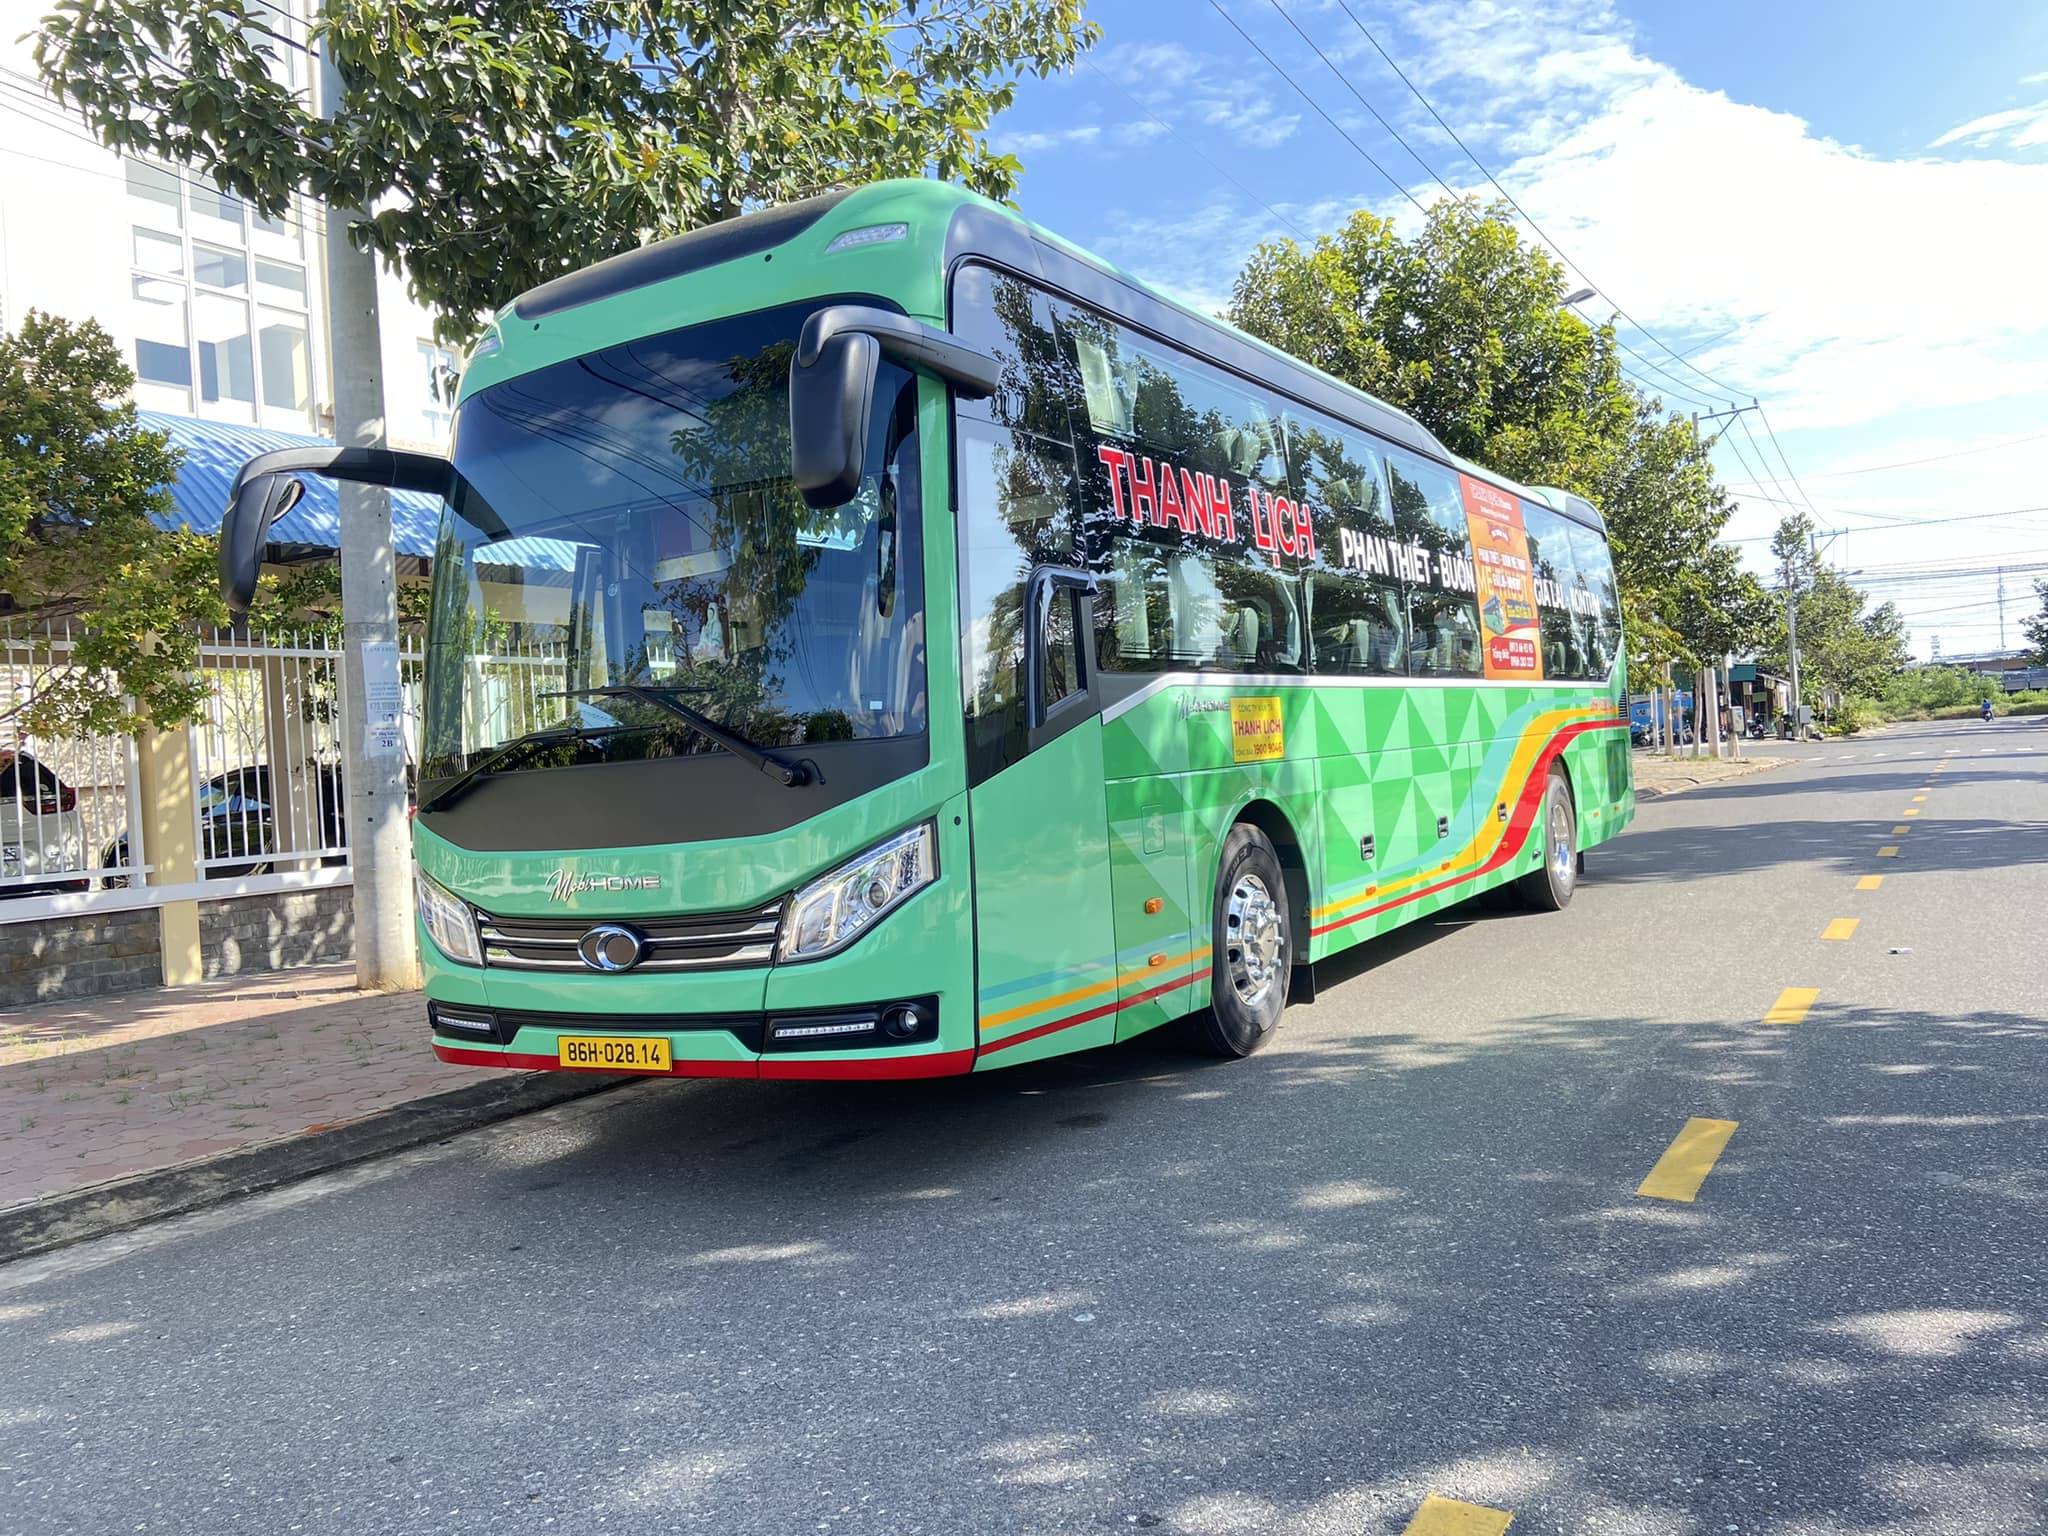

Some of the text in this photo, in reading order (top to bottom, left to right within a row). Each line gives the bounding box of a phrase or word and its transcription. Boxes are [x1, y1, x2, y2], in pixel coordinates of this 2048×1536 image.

[1098, 445, 1316, 568] THANH LỊCH
[1340, 527, 1389, 575] PHAN
[1387, 533, 1430, 584] THIẾT
[1233, 719, 1281, 739] THANH LỊCH
[1253, 743, 1267, 755] 1900
[546, 868, 661, 902] MobiHOME
[567, 1042, 660, 1064] 86H-028.14
